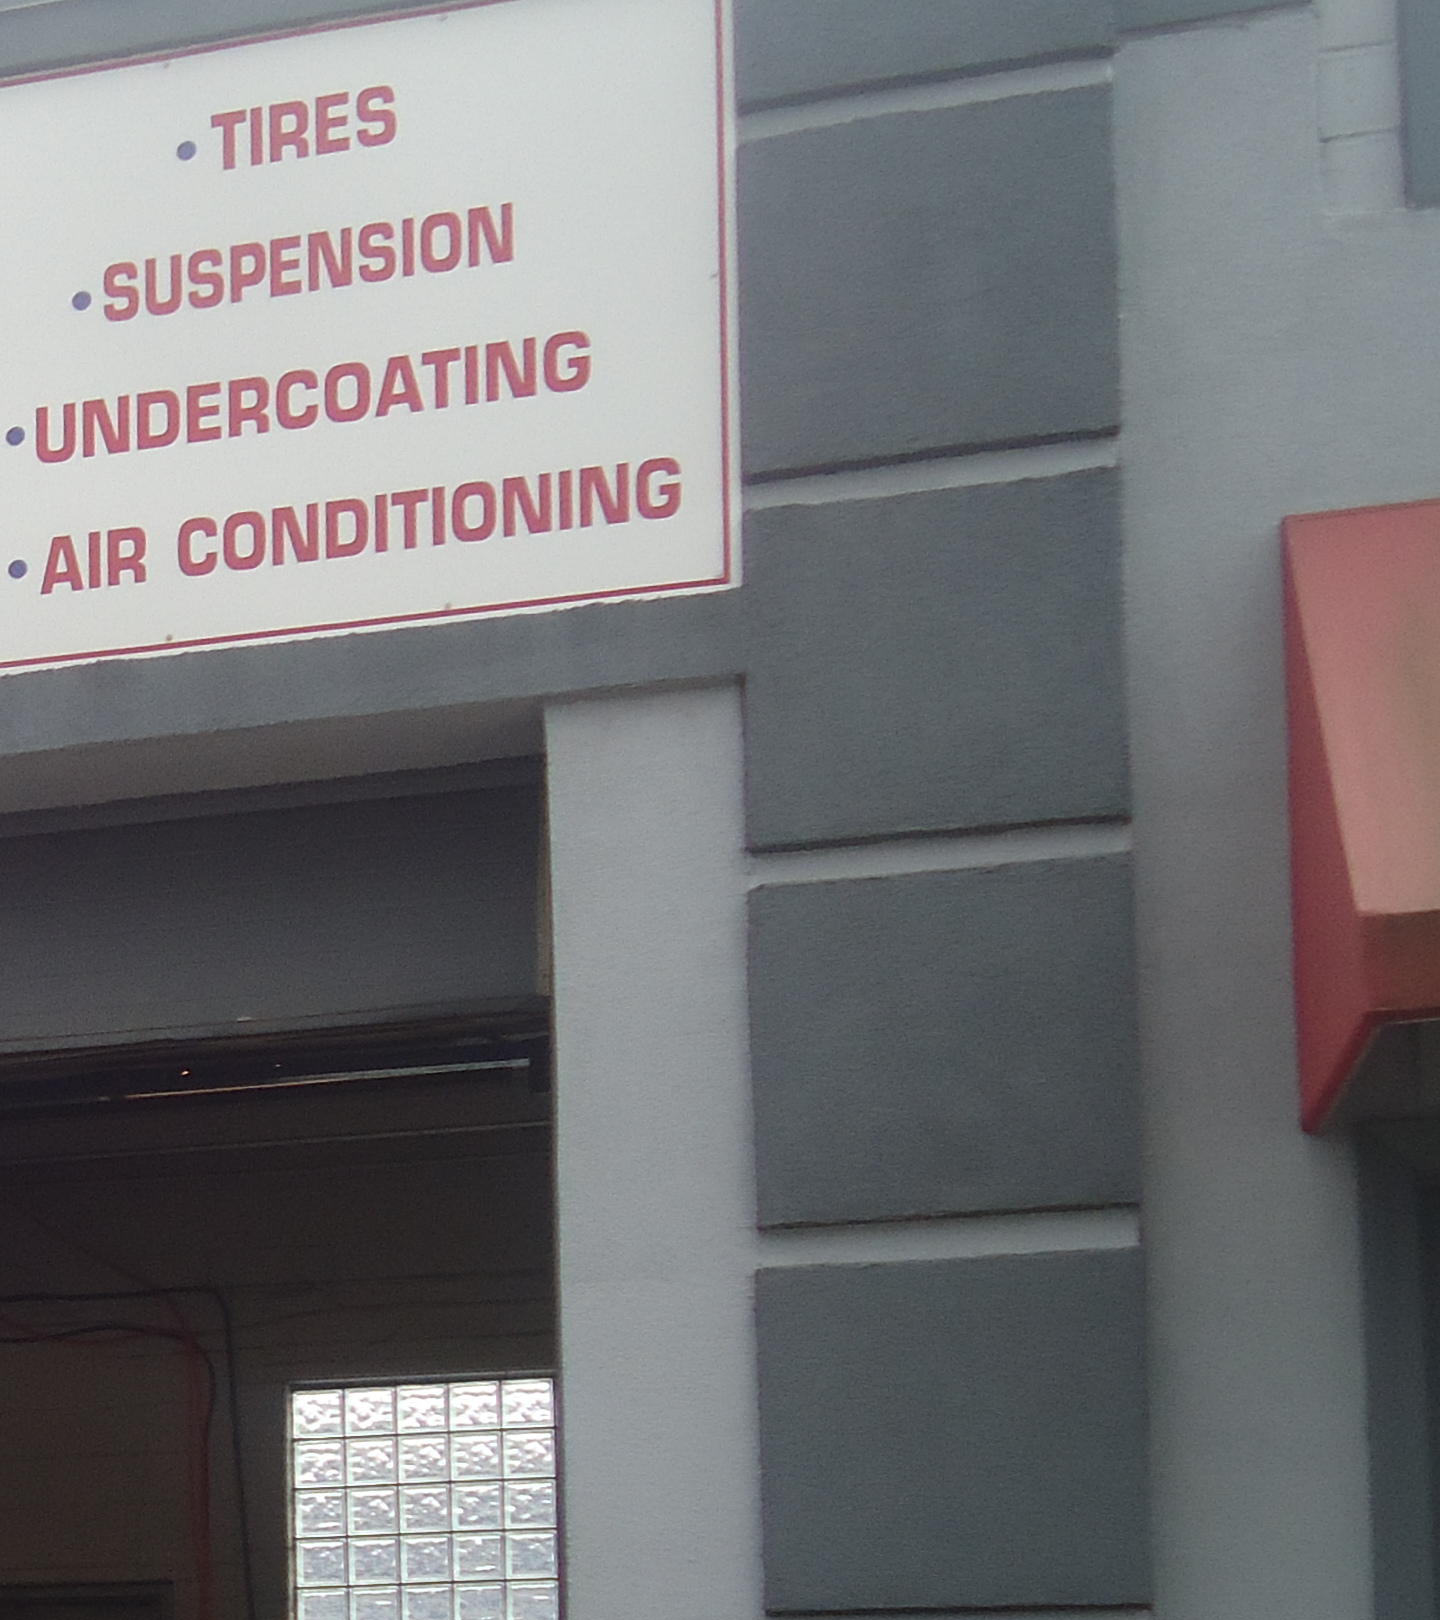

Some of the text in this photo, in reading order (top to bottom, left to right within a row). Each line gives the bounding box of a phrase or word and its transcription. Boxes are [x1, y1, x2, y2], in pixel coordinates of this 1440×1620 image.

[211, 84, 398, 171] TIRES
[102, 201, 515, 323] SUSPENSION
[34, 330, 592, 465] UNDERCOATING
[39, 456, 683, 596] AIR CONDITIONING
